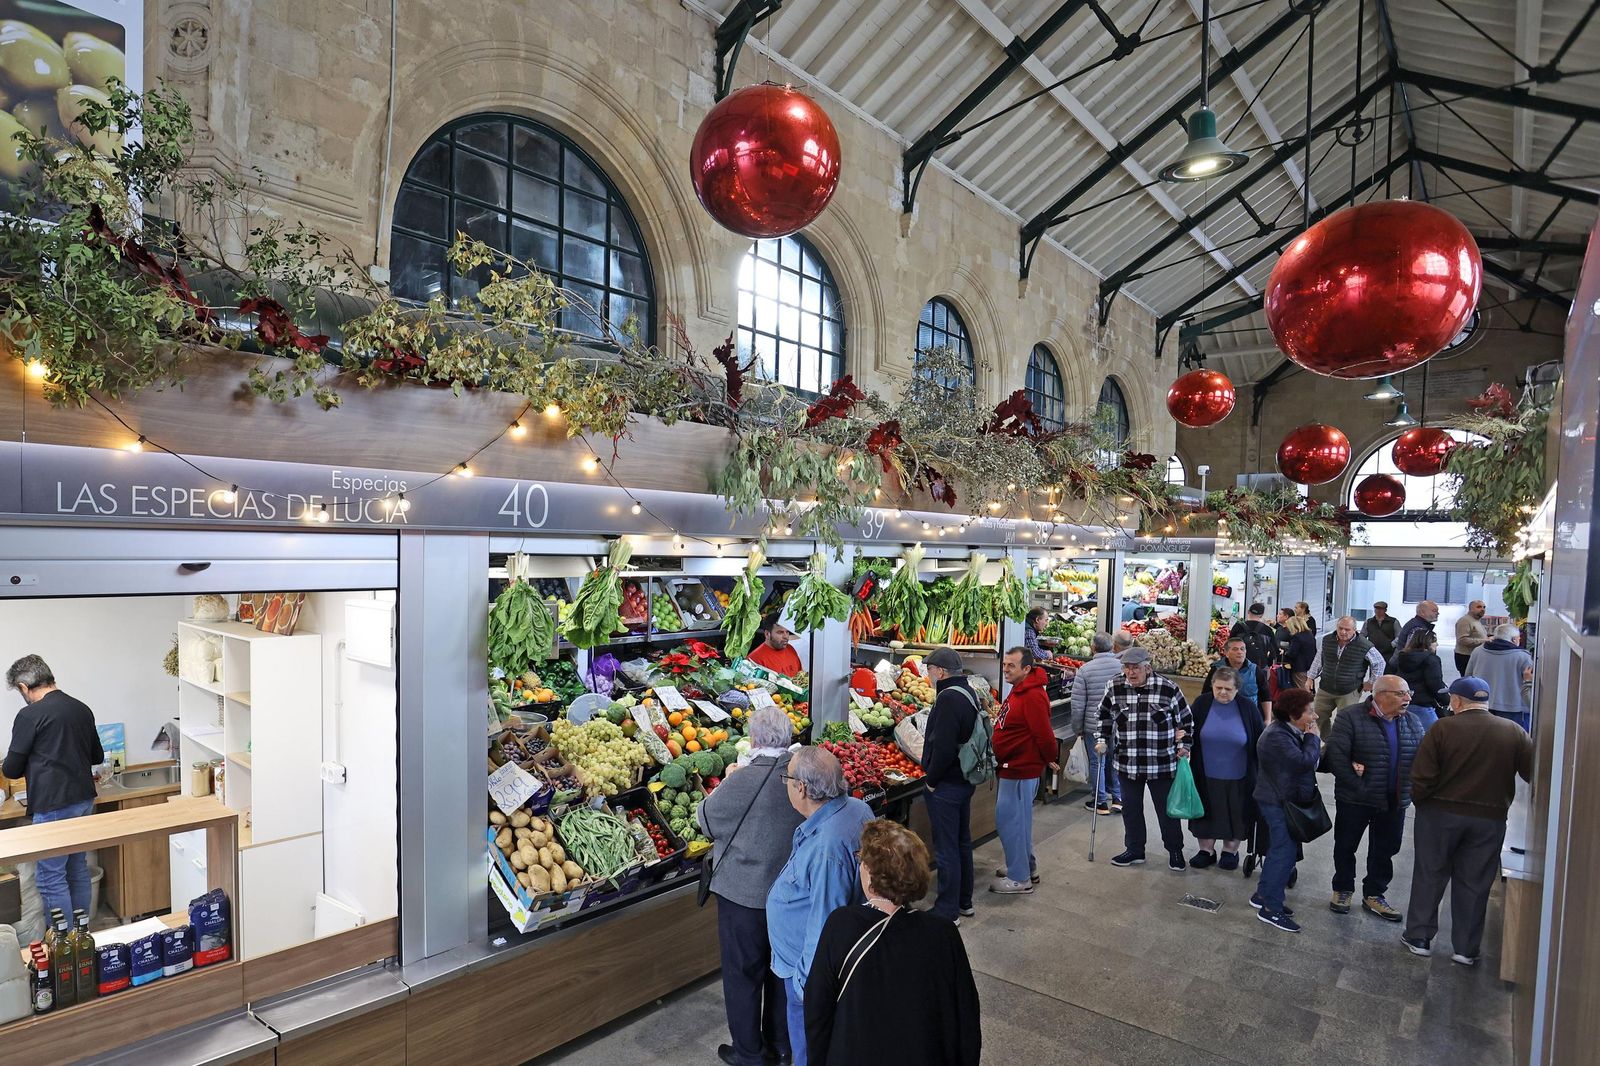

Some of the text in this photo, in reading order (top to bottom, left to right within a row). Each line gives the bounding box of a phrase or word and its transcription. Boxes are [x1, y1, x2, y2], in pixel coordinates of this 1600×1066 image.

[332, 470, 407, 494] Especias
[57, 481, 408, 524] LAS ESPECIAS DE LUCÍA
[498, 482, 549, 528] 40
[862, 508, 885, 540] 39
[1215, 586, 1228, 596] 65
[204, 917, 225, 927] CHALUPA
[167, 945, 188, 955] CHALUPA
[137, 955, 160, 965] CHALUPA
[103, 962, 126, 972] CHALUPA
